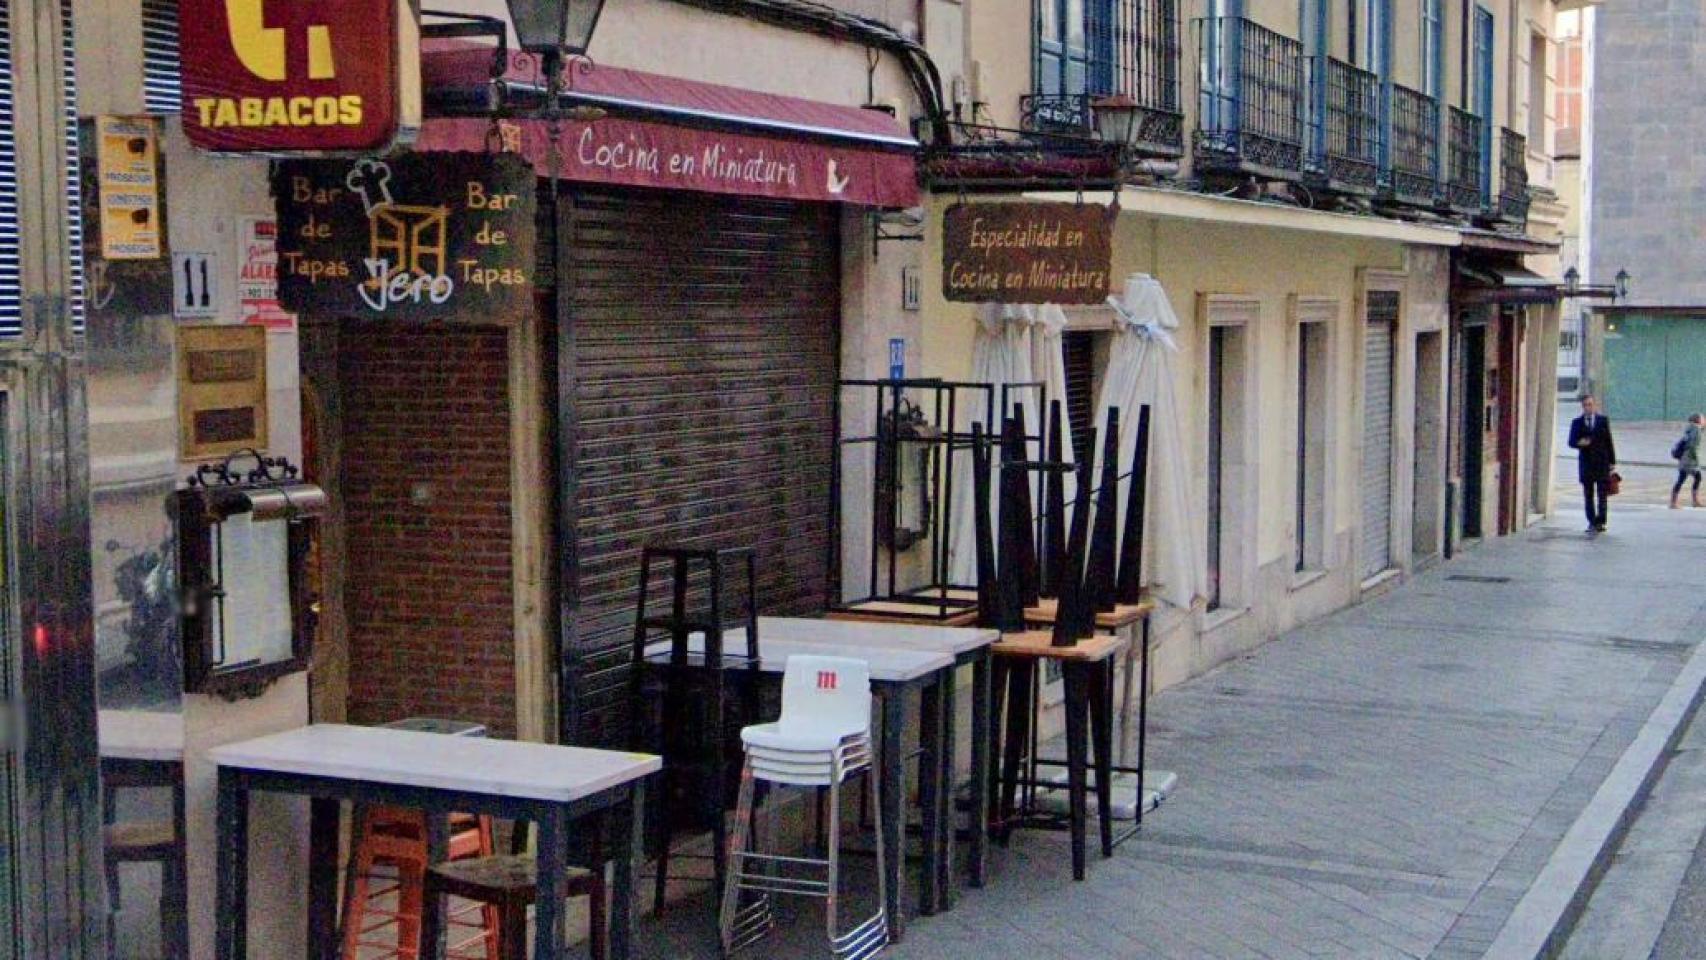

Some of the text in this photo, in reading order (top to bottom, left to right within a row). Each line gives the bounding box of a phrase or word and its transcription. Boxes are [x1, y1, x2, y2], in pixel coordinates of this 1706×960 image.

[194, 96, 363, 127] TABACOS
[579, 127, 797, 186] Cocina en Miniatura
[293, 176, 342, 204] Bar
[466, 180, 518, 211] Bar
[302, 212, 332, 239] de
[475, 220, 507, 246] de
[970, 217, 1083, 257] Especialidad en
[184, 259, 210, 307] 11
[283, 252, 350, 284] Tapas
[457, 259, 525, 292] Tapas
[951, 260, 1105, 289] Cocina en Miniatura
[357, 257, 453, 311] Jero
